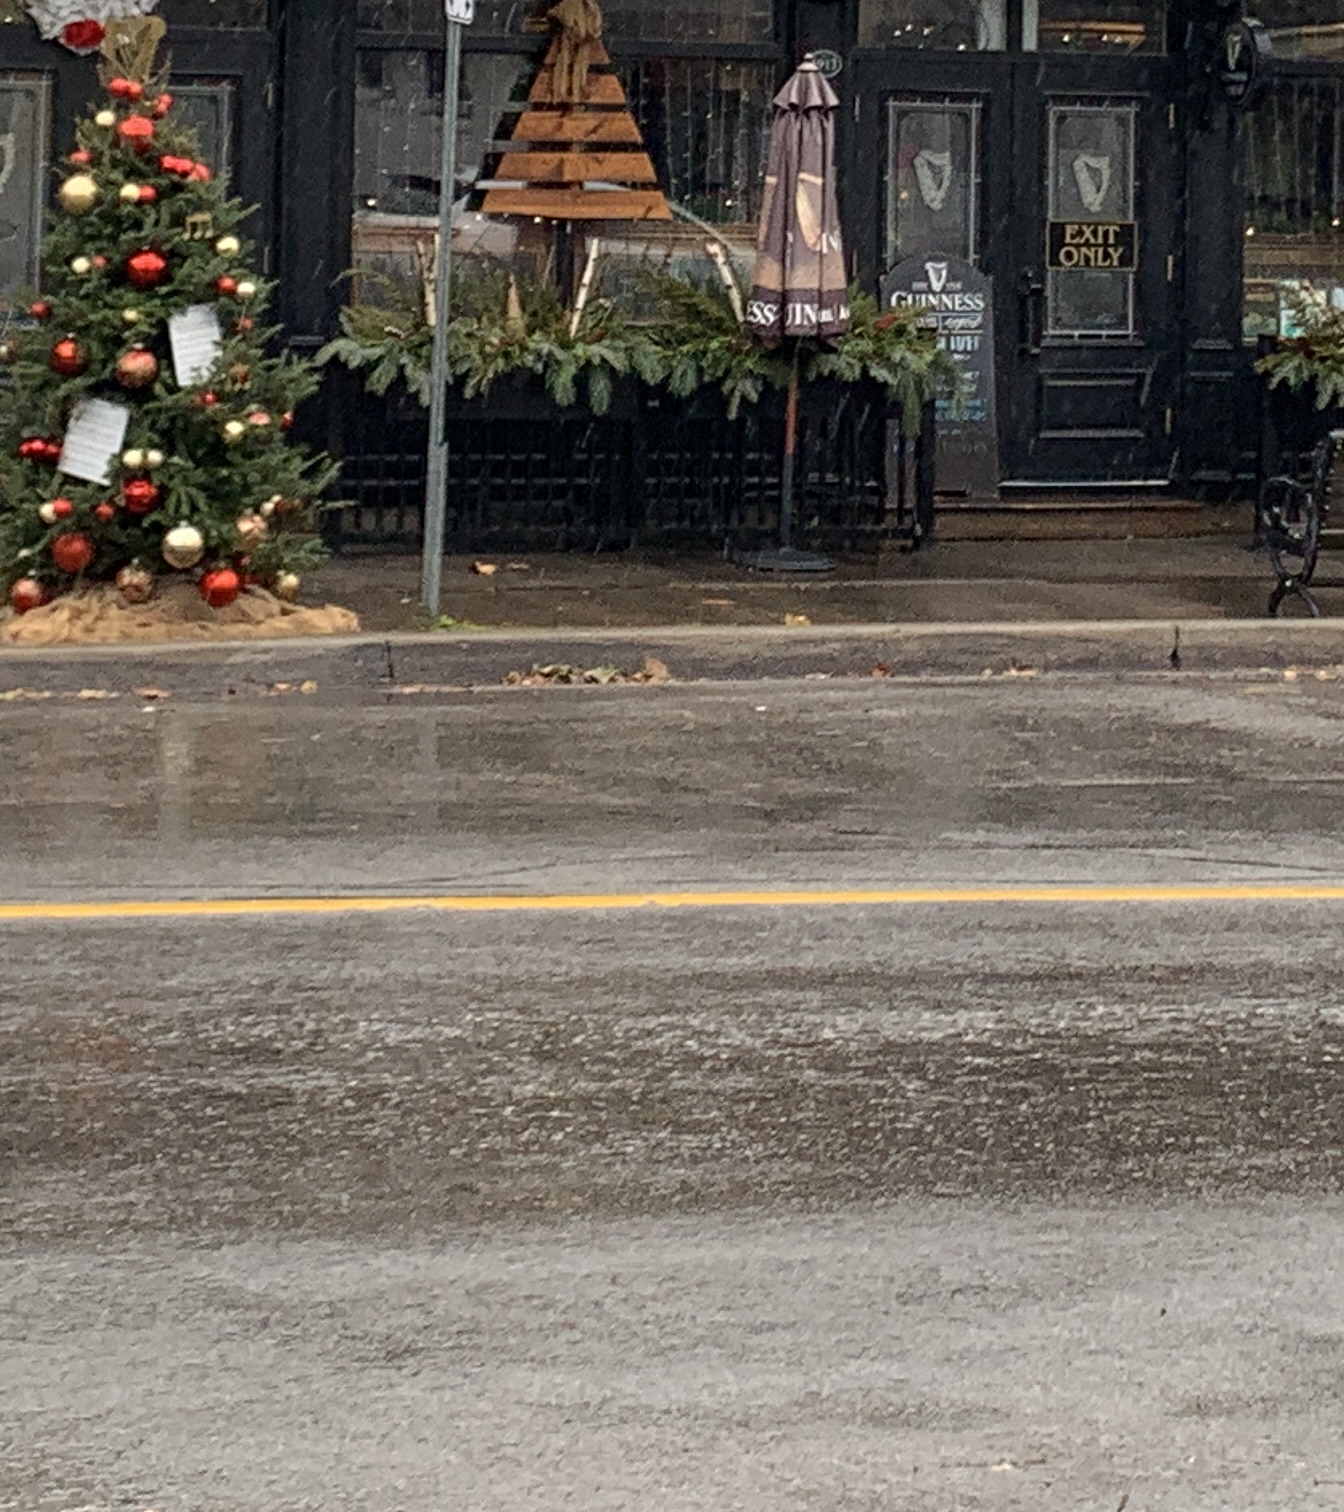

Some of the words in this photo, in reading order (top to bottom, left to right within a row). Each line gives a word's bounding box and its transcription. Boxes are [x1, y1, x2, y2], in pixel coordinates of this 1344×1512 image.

[1063, 223, 1121, 245] EXIT
[1058, 245, 1124, 267] ONLY
[890, 290, 985, 312] GUINNESS
